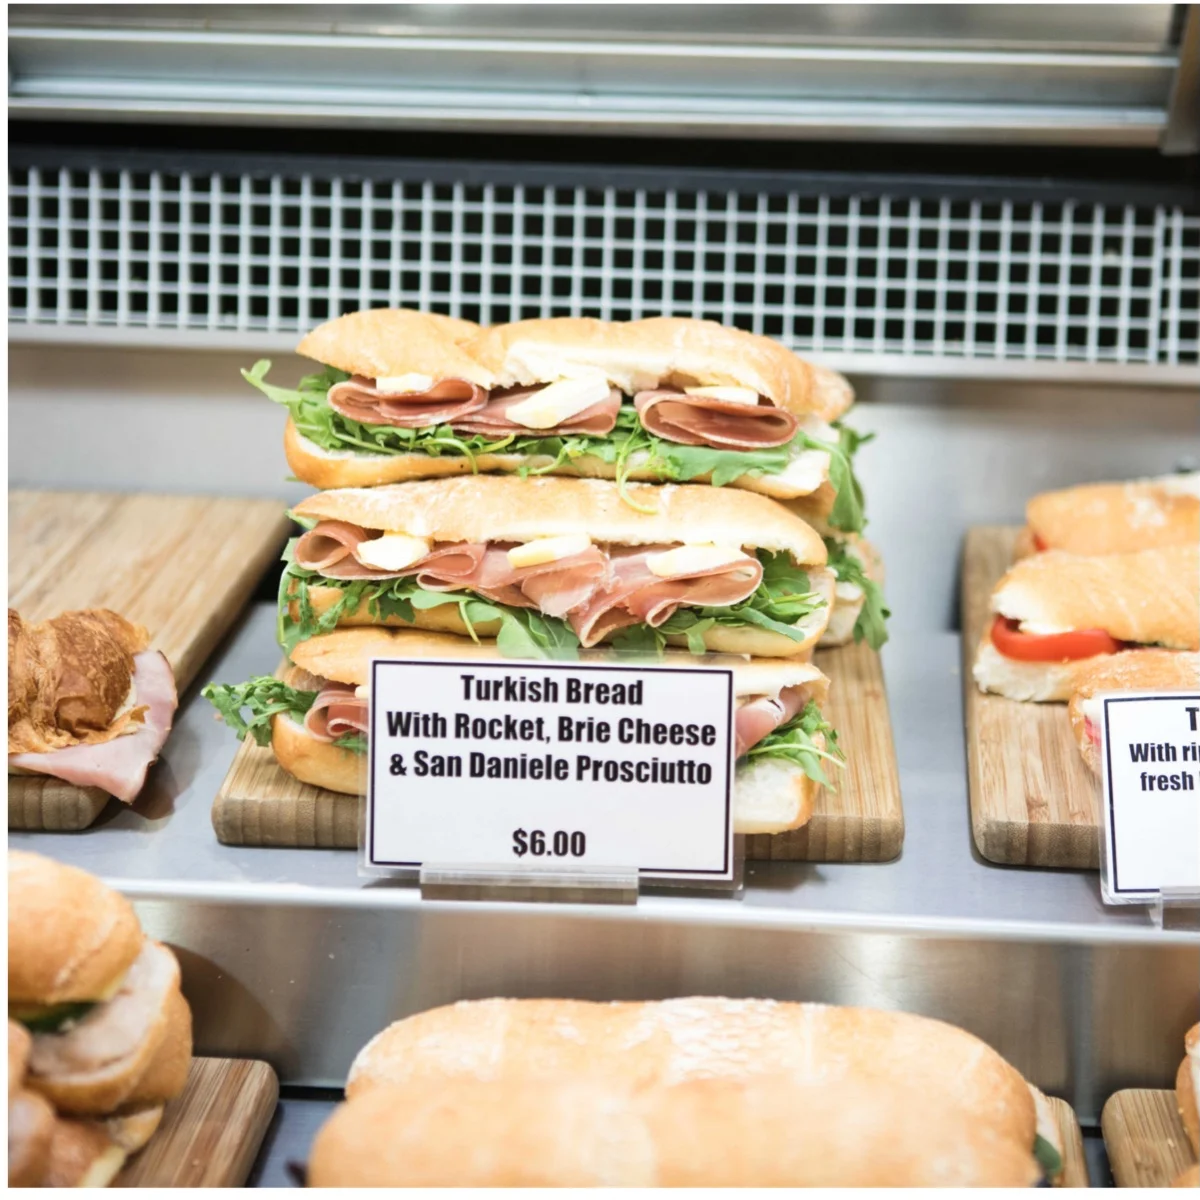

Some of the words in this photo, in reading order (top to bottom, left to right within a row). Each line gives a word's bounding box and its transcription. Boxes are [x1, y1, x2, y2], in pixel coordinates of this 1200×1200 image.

[461, 674, 559, 702] Turkish
[566, 678, 643, 705] Bread
[387, 711, 447, 739] With
[455, 714, 551, 744] Rocket,
[558, 716, 611, 743] Brie
[618, 718, 716, 746] Cheese
[1129, 742, 1177, 762] With
[389, 754, 407, 776] &
[413, 750, 462, 777] San
[470, 752, 569, 781] Daniele
[576, 755, 712, 785] Prosciutto
[1140, 771, 1195, 791] fresh
[512, 828, 586, 858] $6.00
